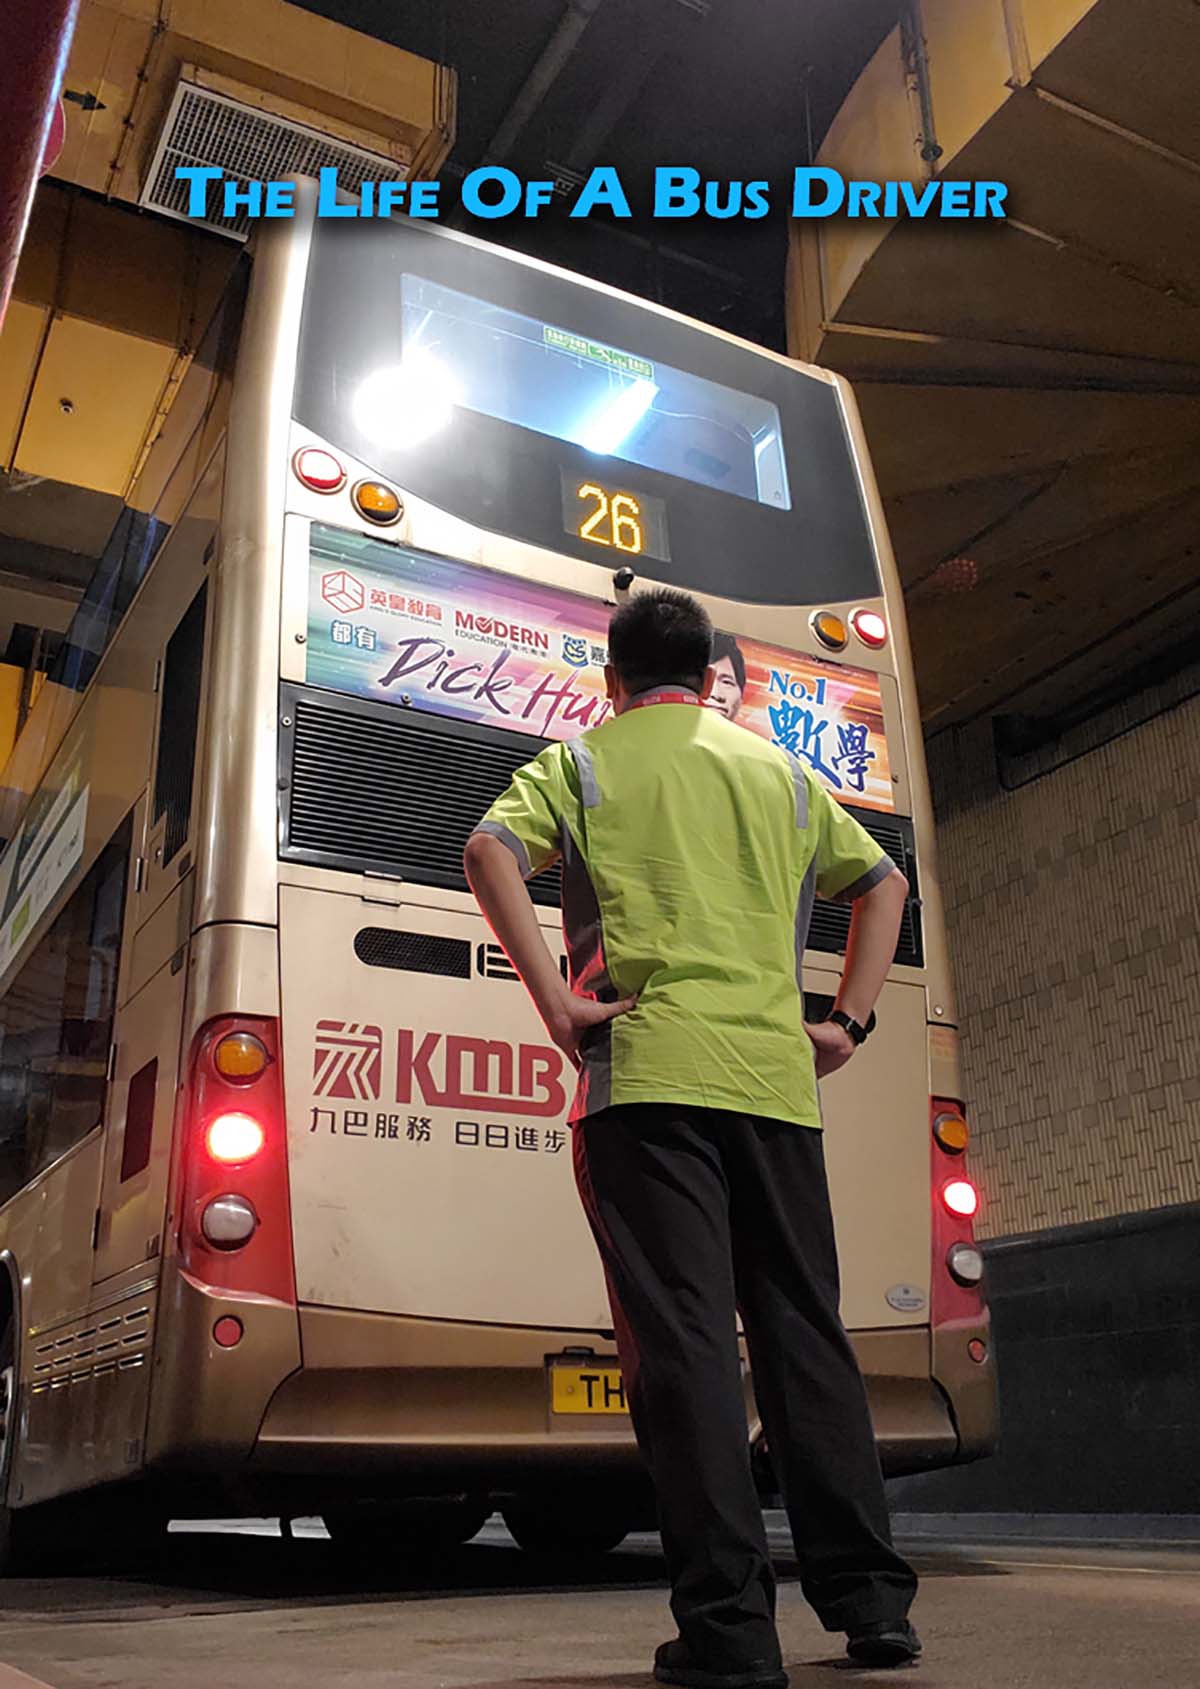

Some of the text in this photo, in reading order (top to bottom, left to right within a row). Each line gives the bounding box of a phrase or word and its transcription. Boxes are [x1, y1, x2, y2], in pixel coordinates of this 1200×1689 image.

[578, 484, 641, 554] 26
[331, 619, 377, 652] 都有
[455, 610, 549, 650] MODERN
[378, 637, 511, 715] Dick
[768, 669, 827, 705] No.1
[455, 1121, 566, 1153] 日日進步
[579, 1374, 625, 1409] TH
